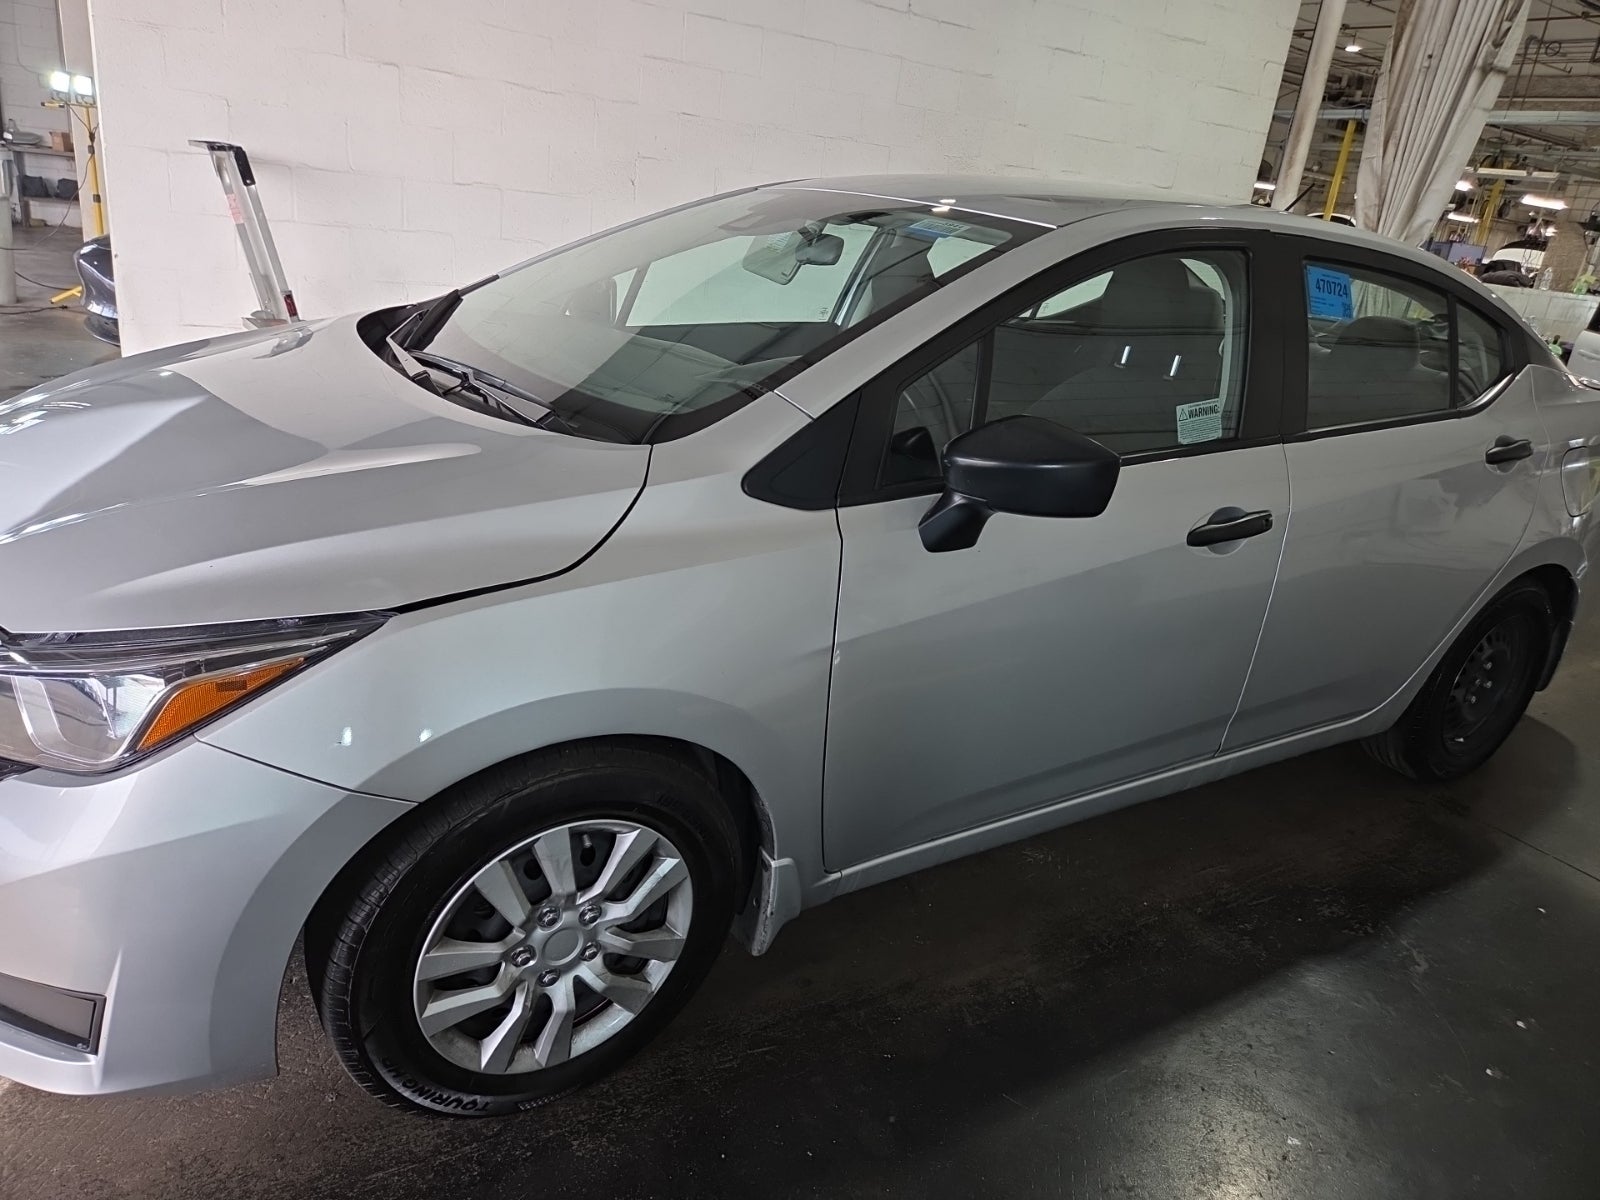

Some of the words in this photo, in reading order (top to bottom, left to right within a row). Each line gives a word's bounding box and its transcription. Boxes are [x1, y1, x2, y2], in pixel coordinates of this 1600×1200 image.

[1315, 278, 1348, 299] 470724
[1188, 404, 1220, 419] WARNING
[401, 1078, 490, 1112] TOURING
